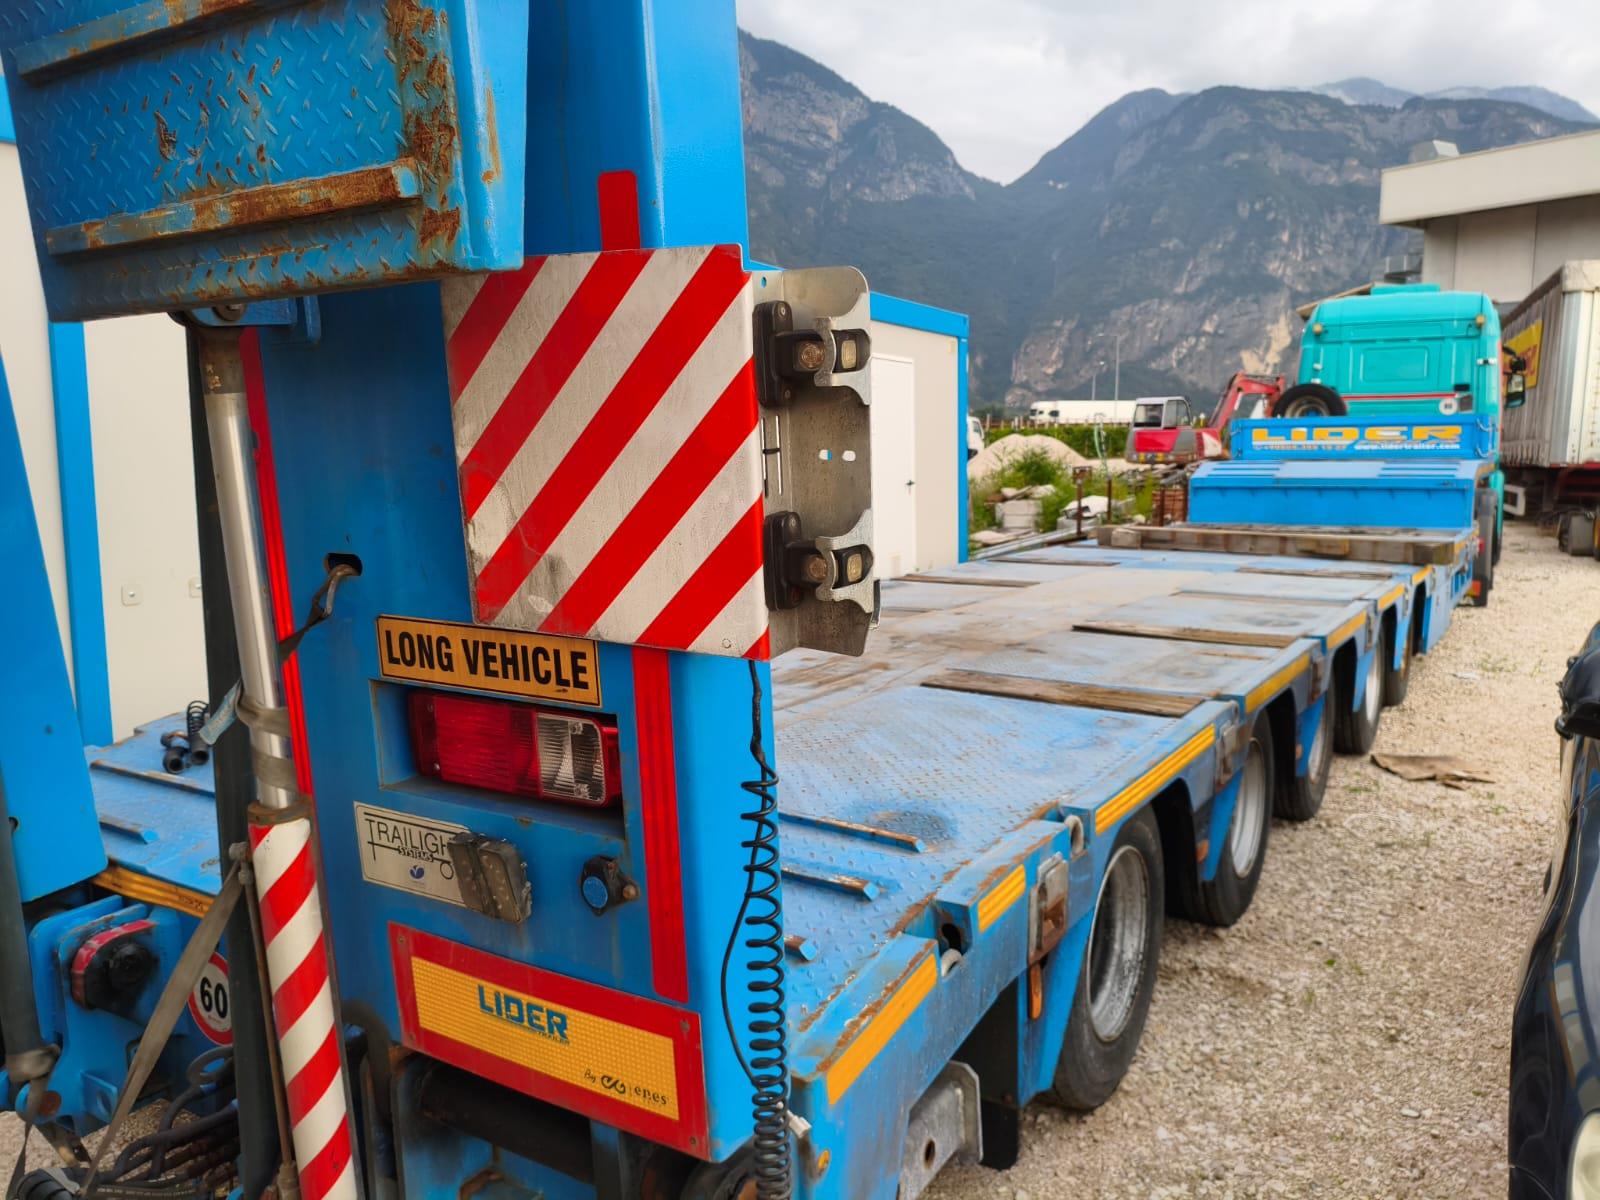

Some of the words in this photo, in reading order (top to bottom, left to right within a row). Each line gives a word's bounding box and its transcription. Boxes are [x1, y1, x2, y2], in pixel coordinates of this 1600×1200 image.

[1252, 426, 1462, 442] LIDER
[385, 630, 454, 673] LONG
[461, 638, 590, 690] VEHICLE
[200, 976, 228, 1019] 60
[477, 983, 569, 1041] LIDER
